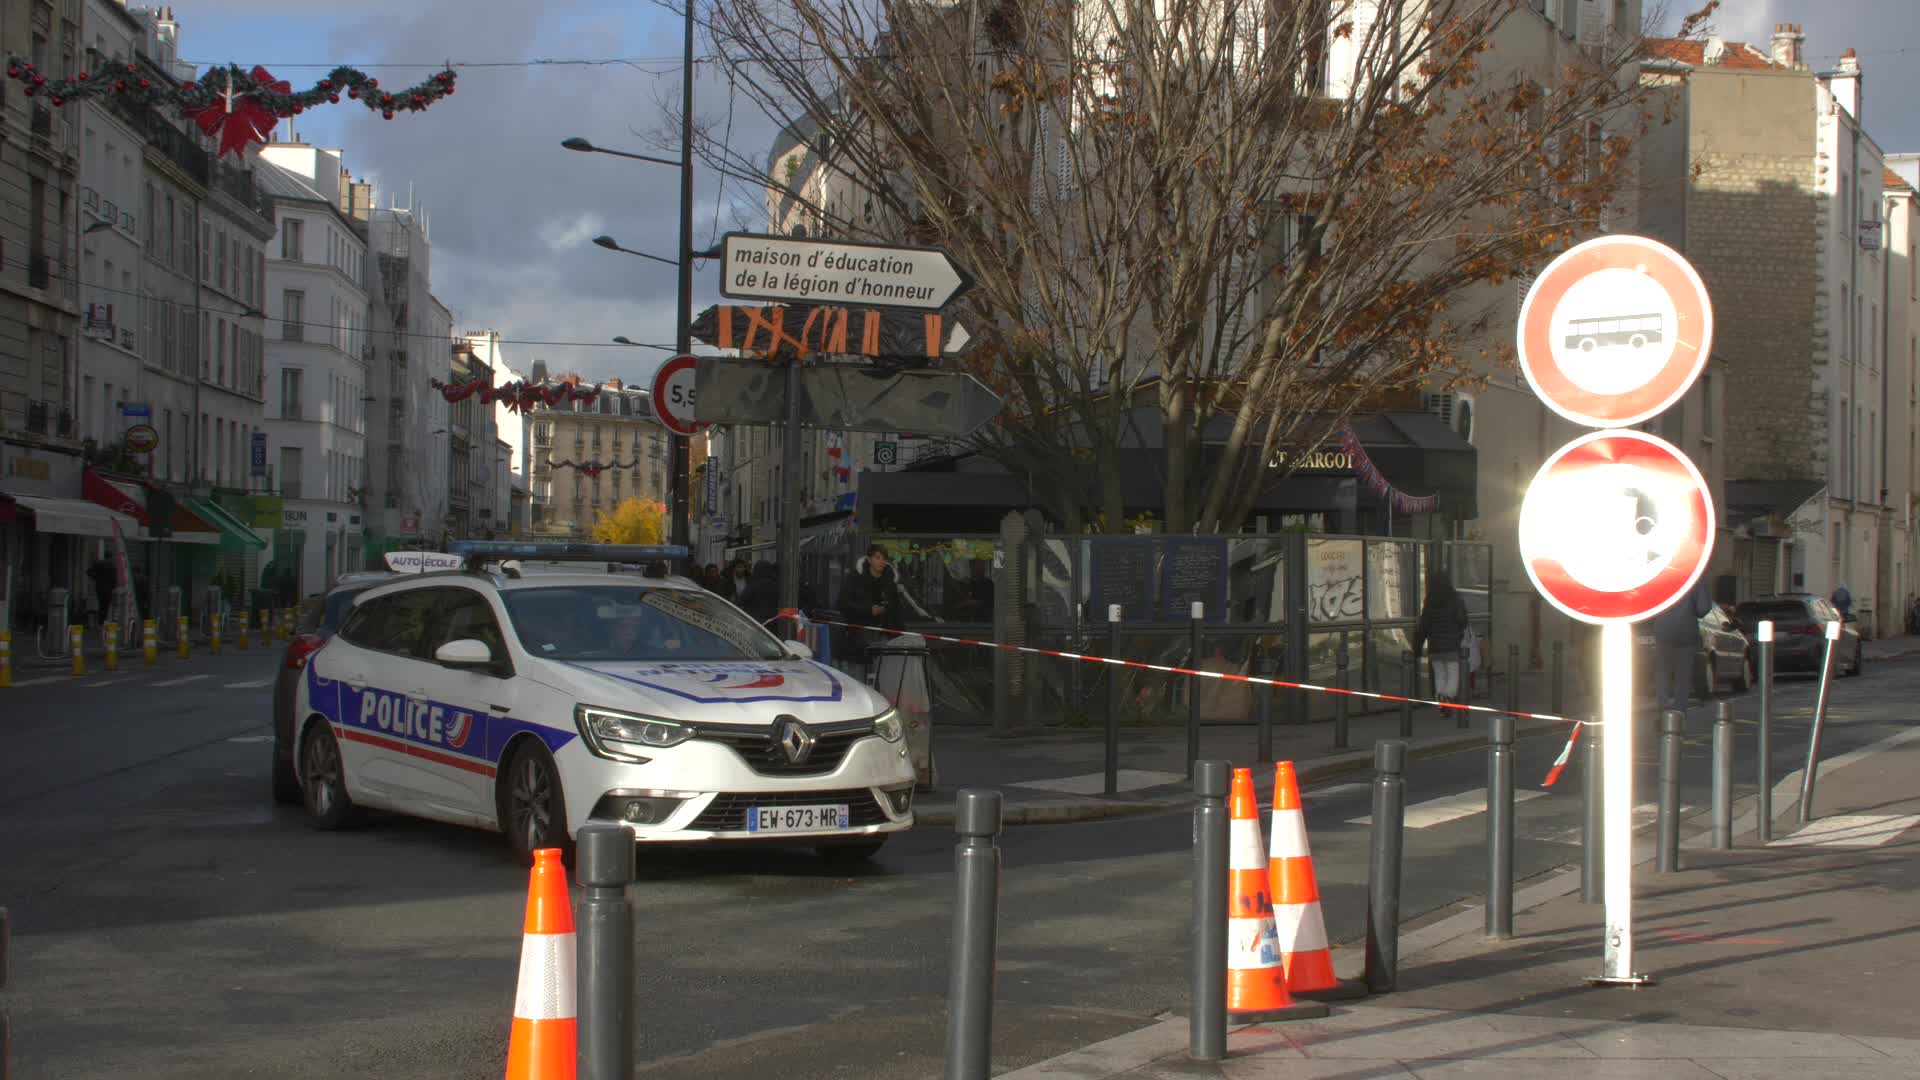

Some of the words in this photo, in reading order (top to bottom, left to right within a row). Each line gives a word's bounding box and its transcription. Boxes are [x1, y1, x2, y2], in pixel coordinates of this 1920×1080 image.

[735, 247, 801, 267] maison
[807, 251, 913, 275] d'éducation
[735, 270, 757, 288] de
[762, 272, 778, 290] la
[784, 273, 839, 296] légion
[845, 278, 935, 300] d'honneur
[360, 691, 444, 744] POLICE
[760, 807, 837, 829] EW-673-MR
